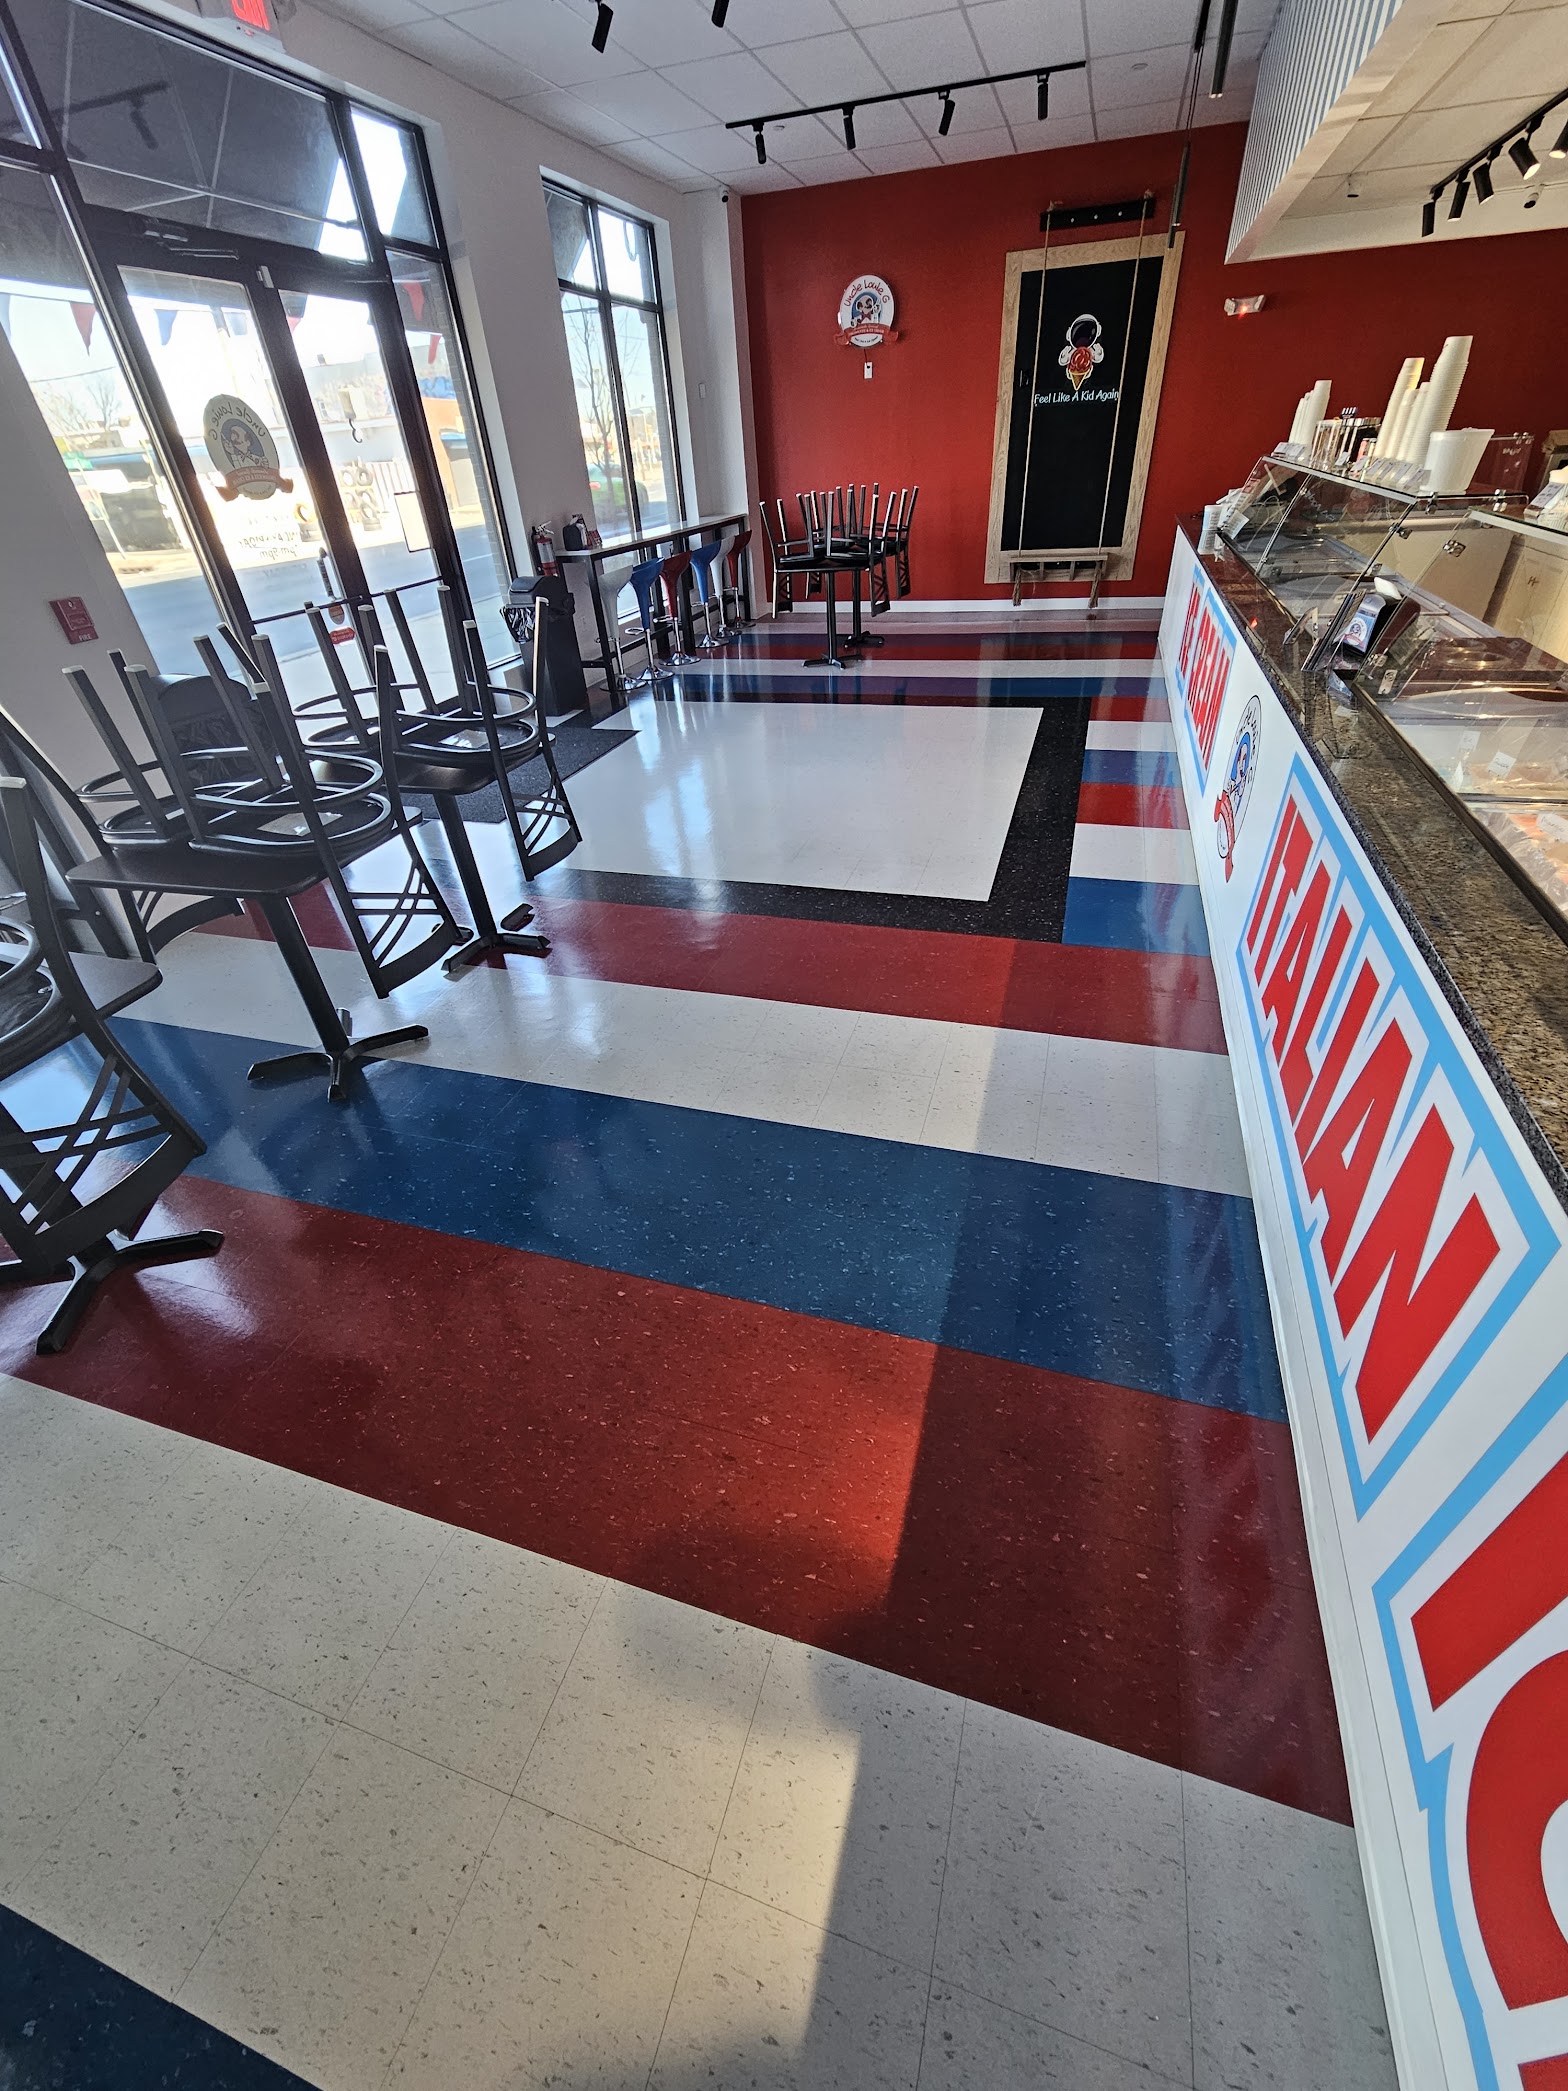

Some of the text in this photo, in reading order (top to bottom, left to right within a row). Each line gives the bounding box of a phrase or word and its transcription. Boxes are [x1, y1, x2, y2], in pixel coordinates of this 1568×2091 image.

[844, 280, 890, 306] Uncle Louie G
[1034, 388, 1119, 404] Feel Like A Kid Again
[1178, 582, 1201, 678] ICE
[1188, 607, 1230, 770] CREAM
[1247, 795, 1504, 1442] ITALIAN
